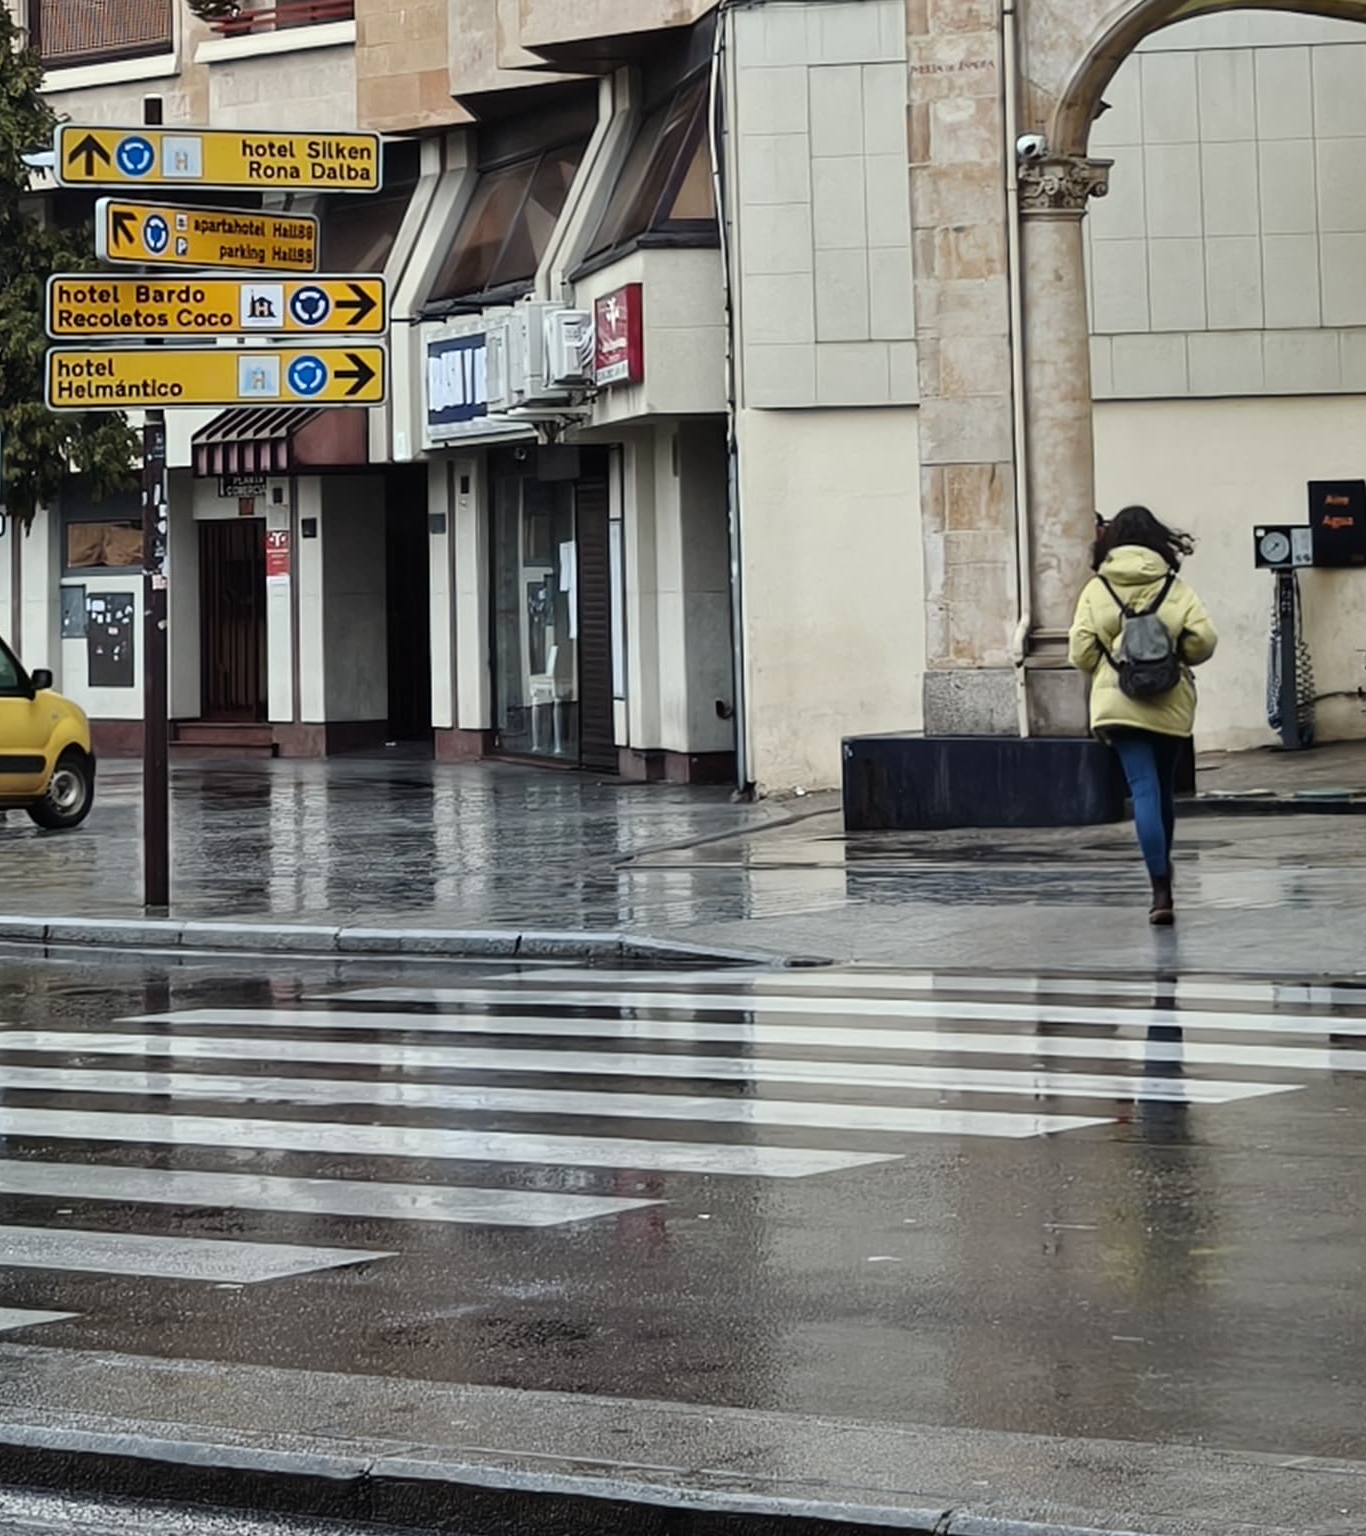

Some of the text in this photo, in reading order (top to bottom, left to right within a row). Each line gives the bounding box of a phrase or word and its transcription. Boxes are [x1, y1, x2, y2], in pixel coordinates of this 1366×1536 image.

[242, 140, 296, 158] hotel
[307, 142, 372, 160] Silken
[249, 161, 371, 180] Rona Dalba
[194, 219, 265, 237] apartahotel
[219, 245, 265, 263] parking
[58, 285, 205, 304] hotel Bardo
[58, 309, 233, 328] Recoletos Coco
[57, 359, 114, 377] hotel
[57, 380, 183, 398] Helmántico
